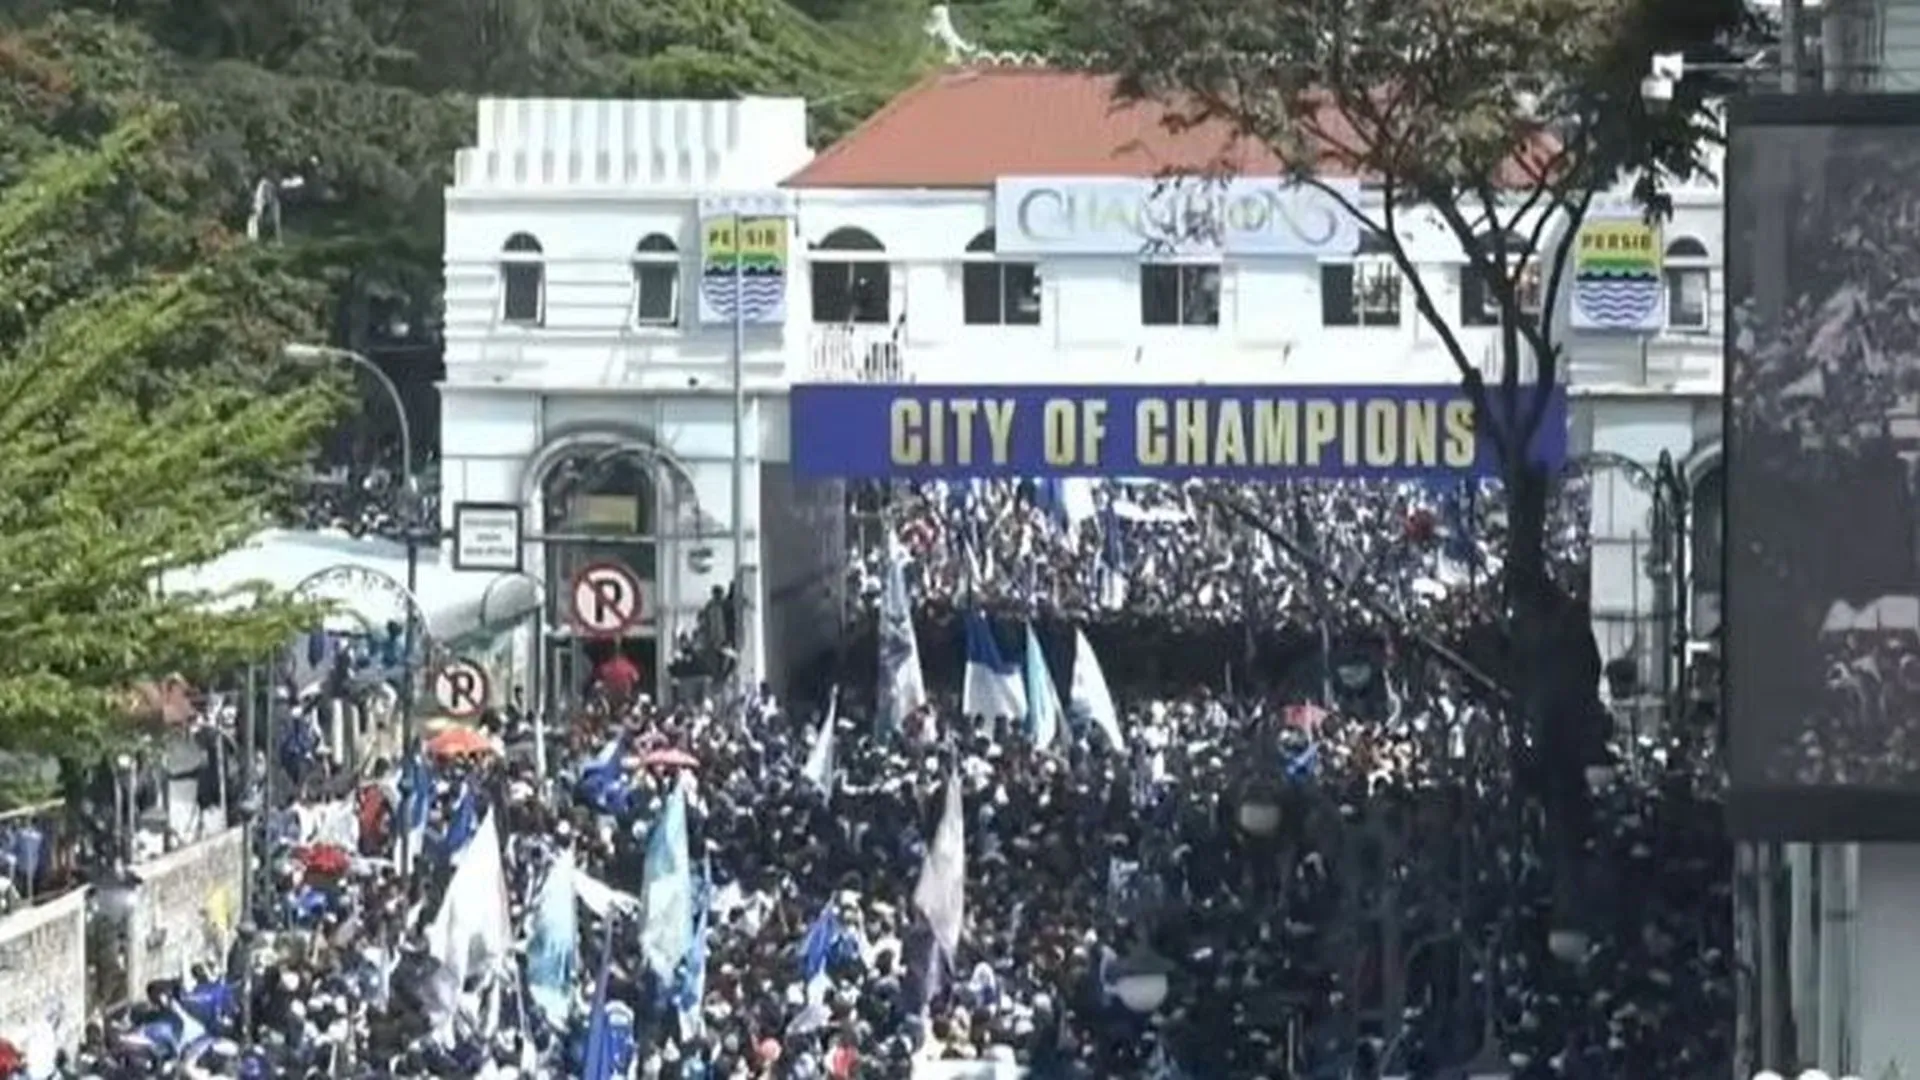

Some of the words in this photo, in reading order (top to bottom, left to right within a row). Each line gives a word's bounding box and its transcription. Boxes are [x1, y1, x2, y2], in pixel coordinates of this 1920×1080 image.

[709, 229, 777, 246] PESIB
[1581, 233, 1652, 250] PERSIB
[890, 397, 1016, 466] CITY
[1043, 397, 1107, 466] OF
[1136, 397, 1476, 467] CHAMPIONS
